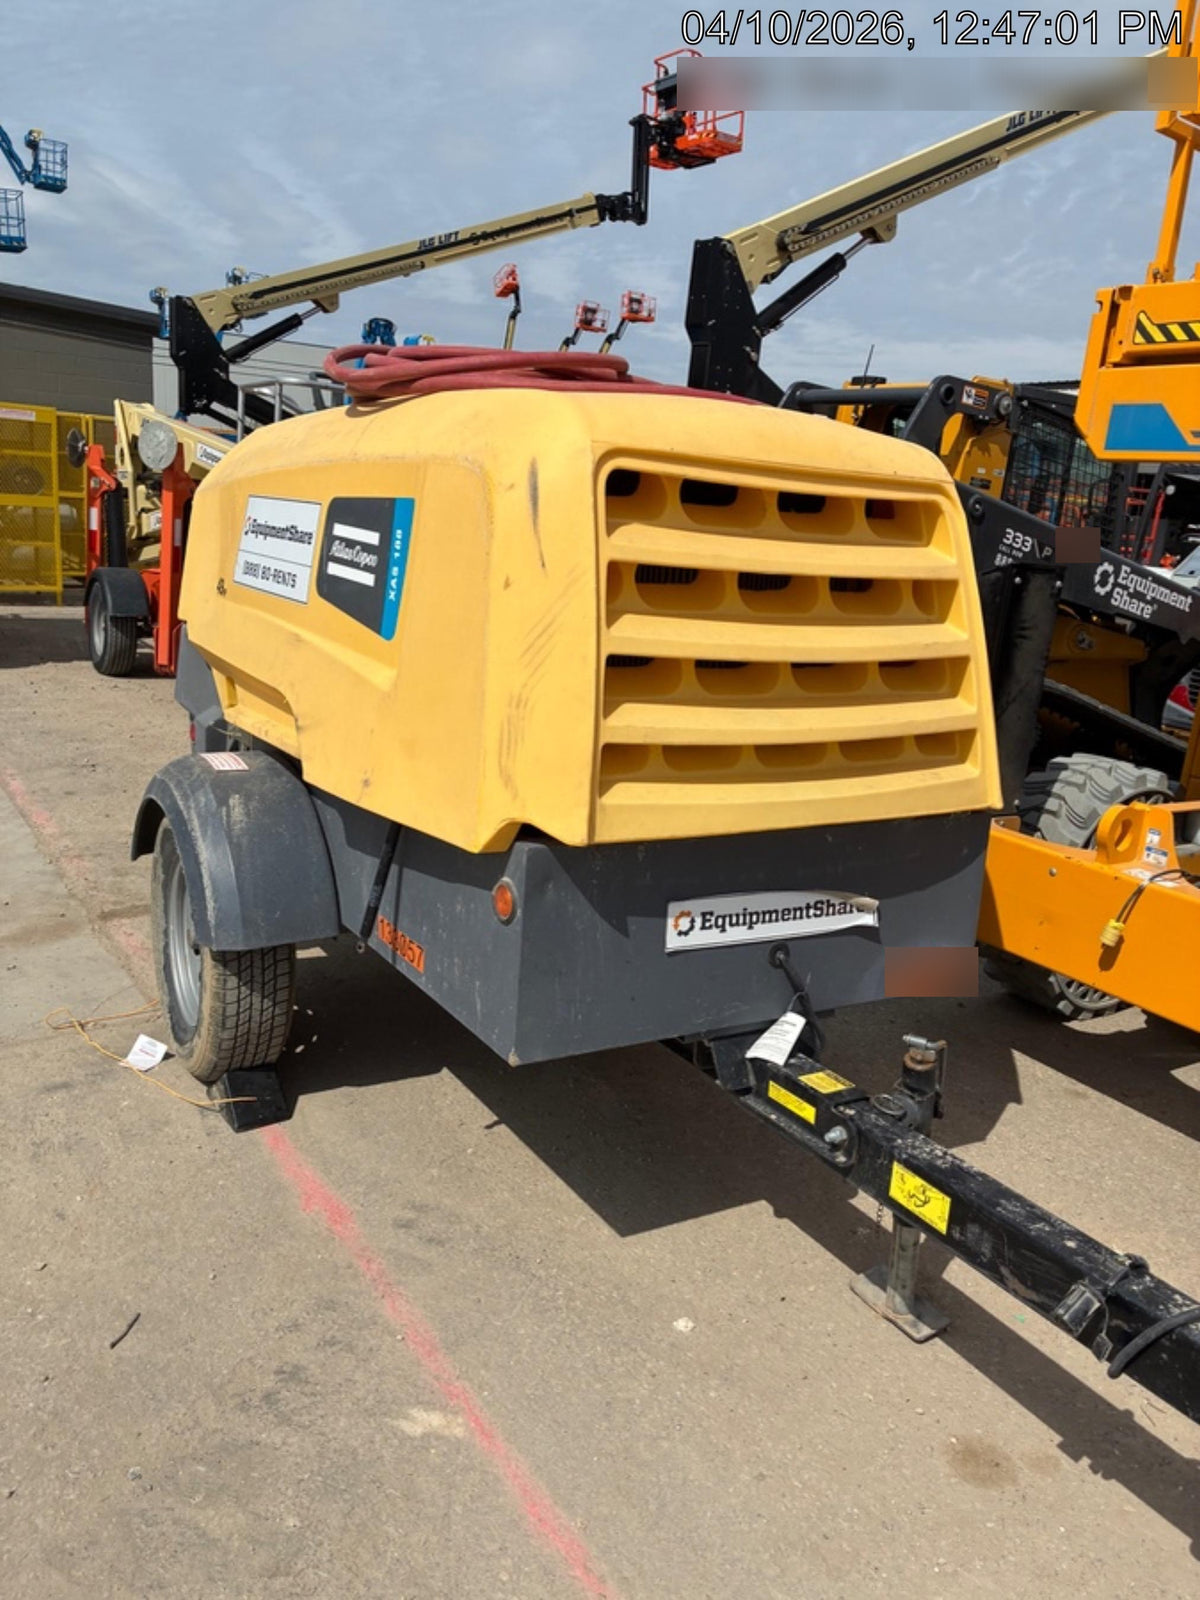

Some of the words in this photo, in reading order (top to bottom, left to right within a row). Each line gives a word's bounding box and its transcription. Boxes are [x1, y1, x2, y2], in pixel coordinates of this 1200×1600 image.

[1006, 112, 1026, 132] JLG
[417, 239, 436, 250] JLG
[438, 231, 460, 246] LIFT
[250, 518, 313, 545] EquipmentShare
[1002, 527, 1033, 552] 333
[388, 566, 400, 602] XAS
[1117, 565, 1193, 612] Equipment
[1110, 587, 1153, 619] Share
